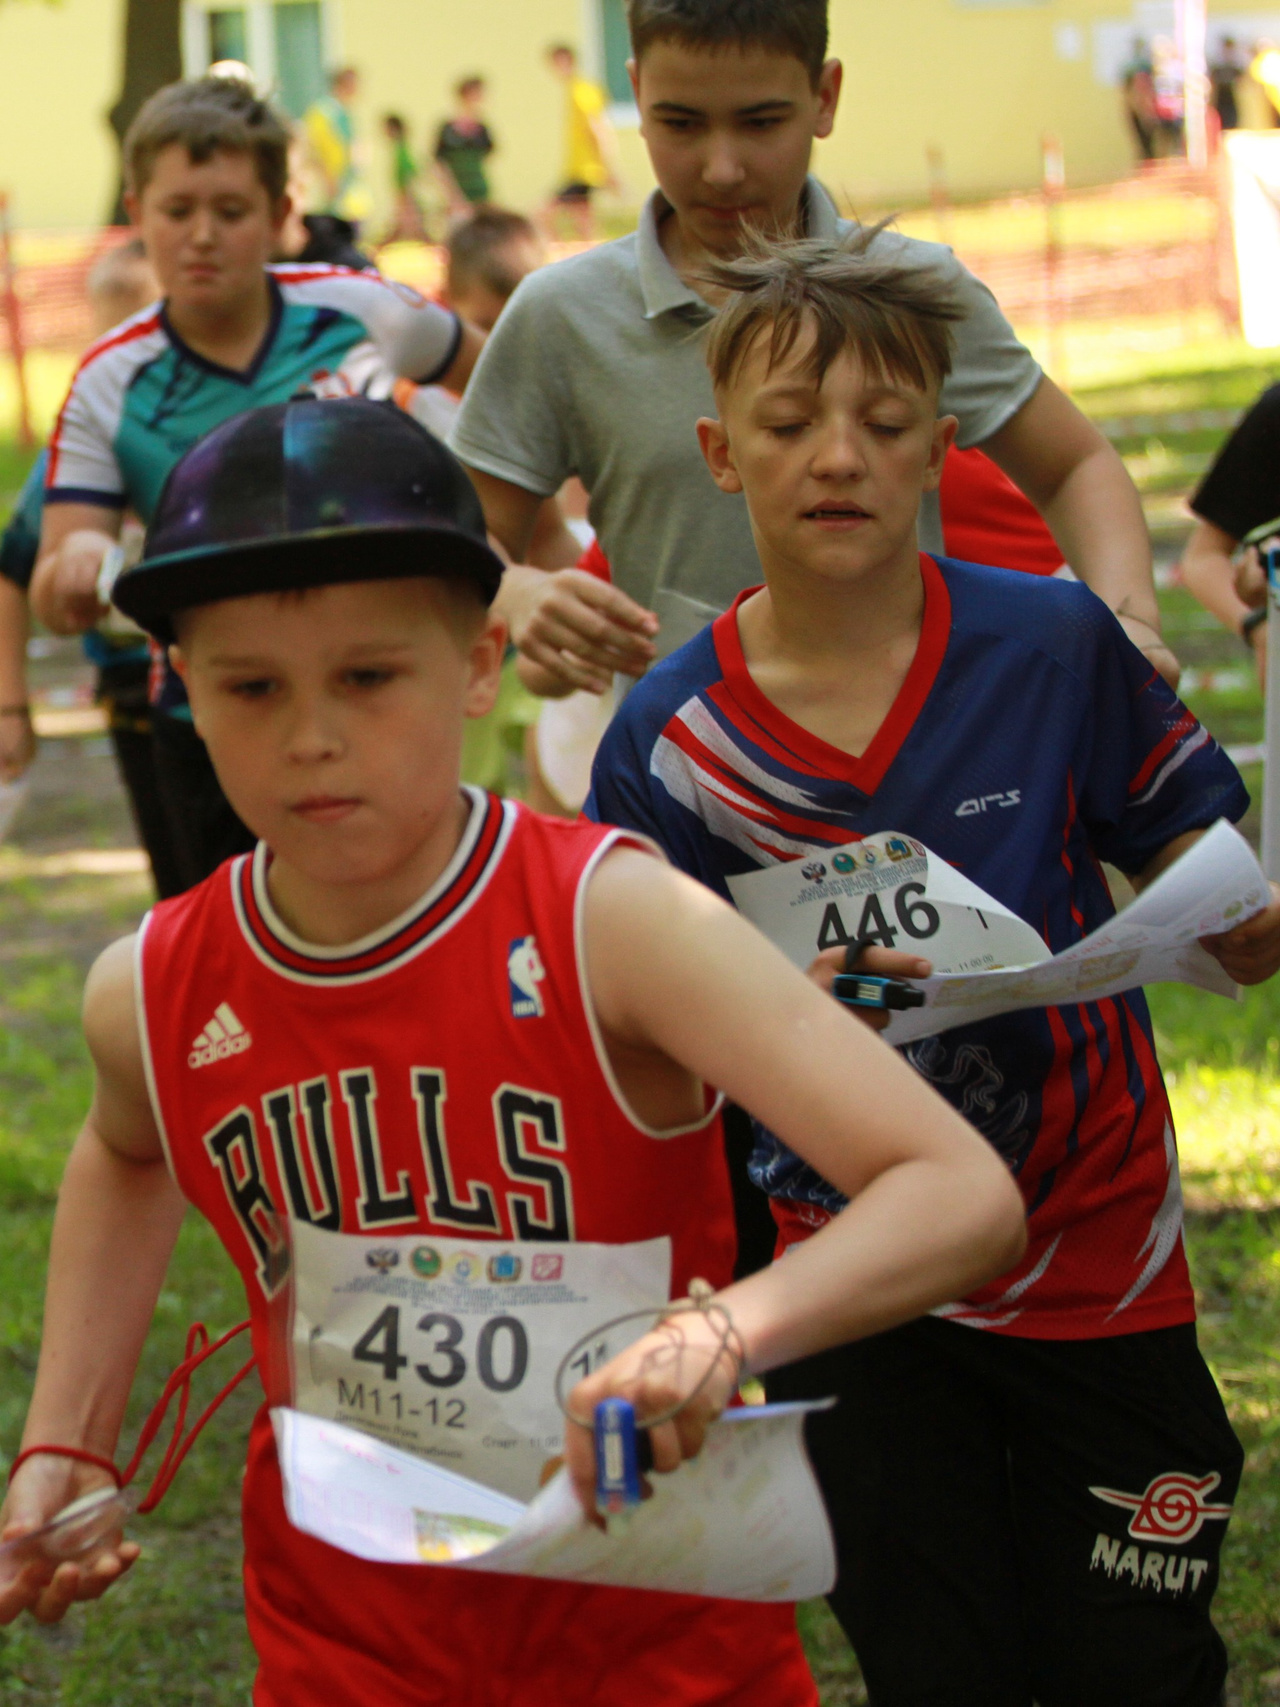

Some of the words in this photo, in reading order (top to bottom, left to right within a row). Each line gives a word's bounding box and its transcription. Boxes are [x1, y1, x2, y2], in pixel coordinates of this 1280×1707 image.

[954, 788, 1022, 818] ars
[816, 882, 941, 952] 446
[513, 1000, 537, 1017] NBA
[187, 1032, 253, 1069] adidas
[202, 1066, 576, 1302] BULLS
[352, 1304, 530, 1393] 430
[337, 1377, 467, 1429] М11-12
[1089, 1533, 1208, 1600] NARUT
